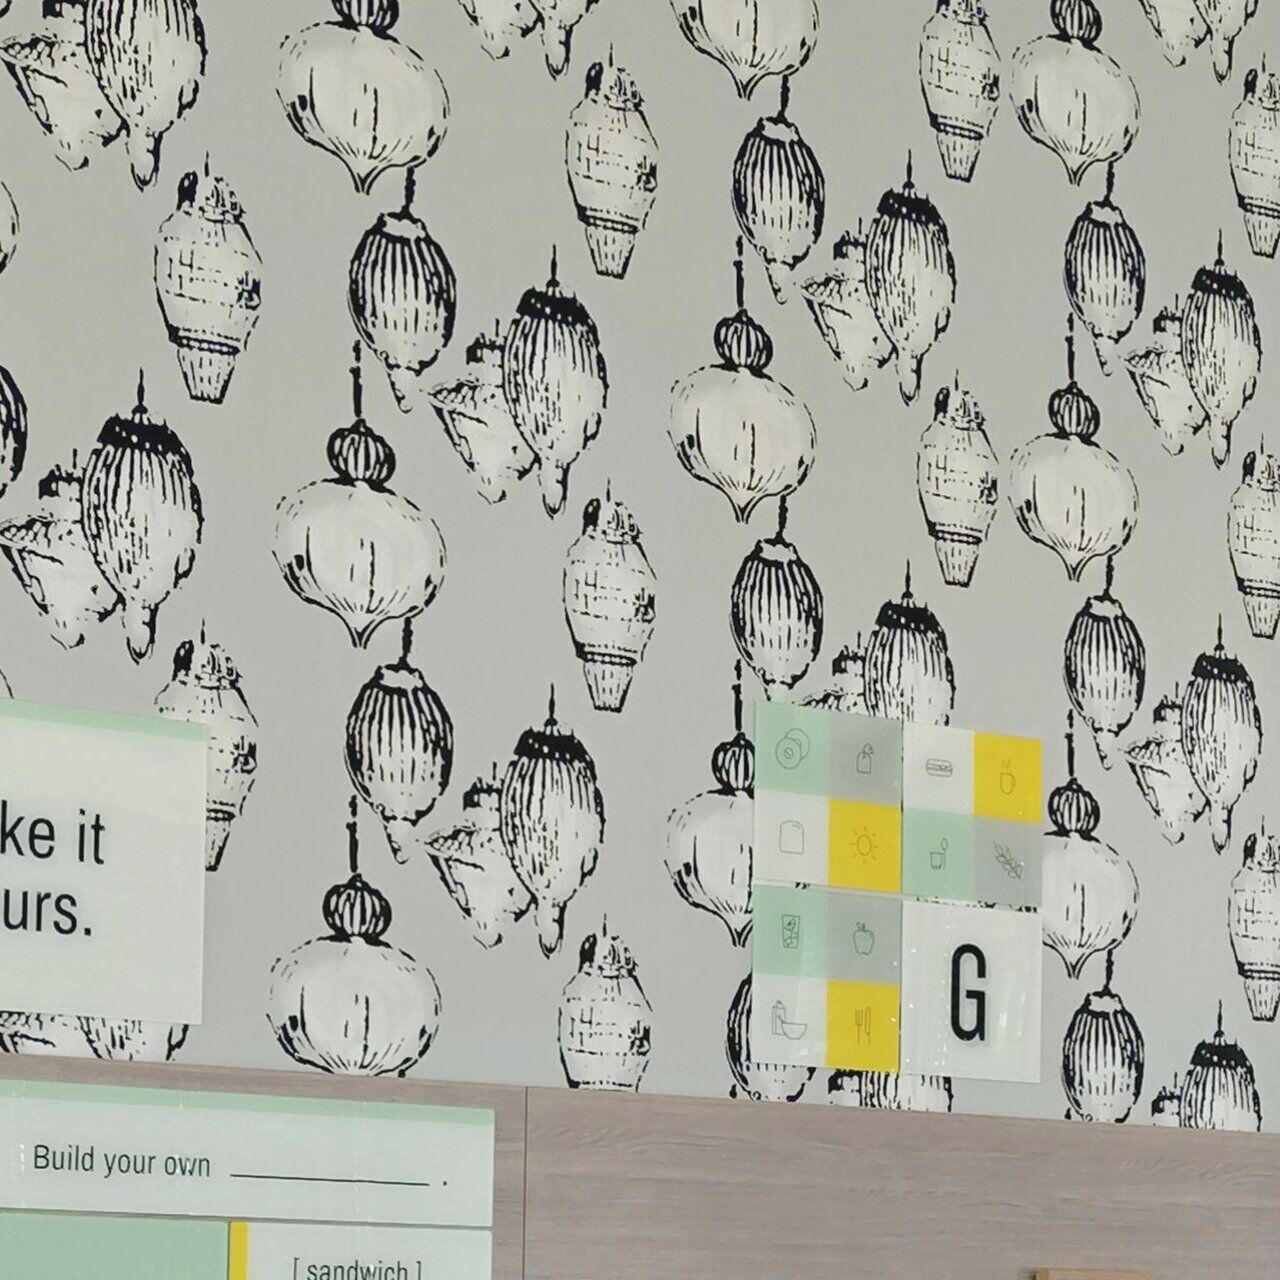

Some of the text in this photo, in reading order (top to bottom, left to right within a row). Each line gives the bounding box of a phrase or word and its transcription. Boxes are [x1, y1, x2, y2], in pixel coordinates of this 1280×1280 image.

[77, 807, 106, 866] it
[949, 942, 988, 1043] G
[33, 1144, 211, 1179] Build your own
